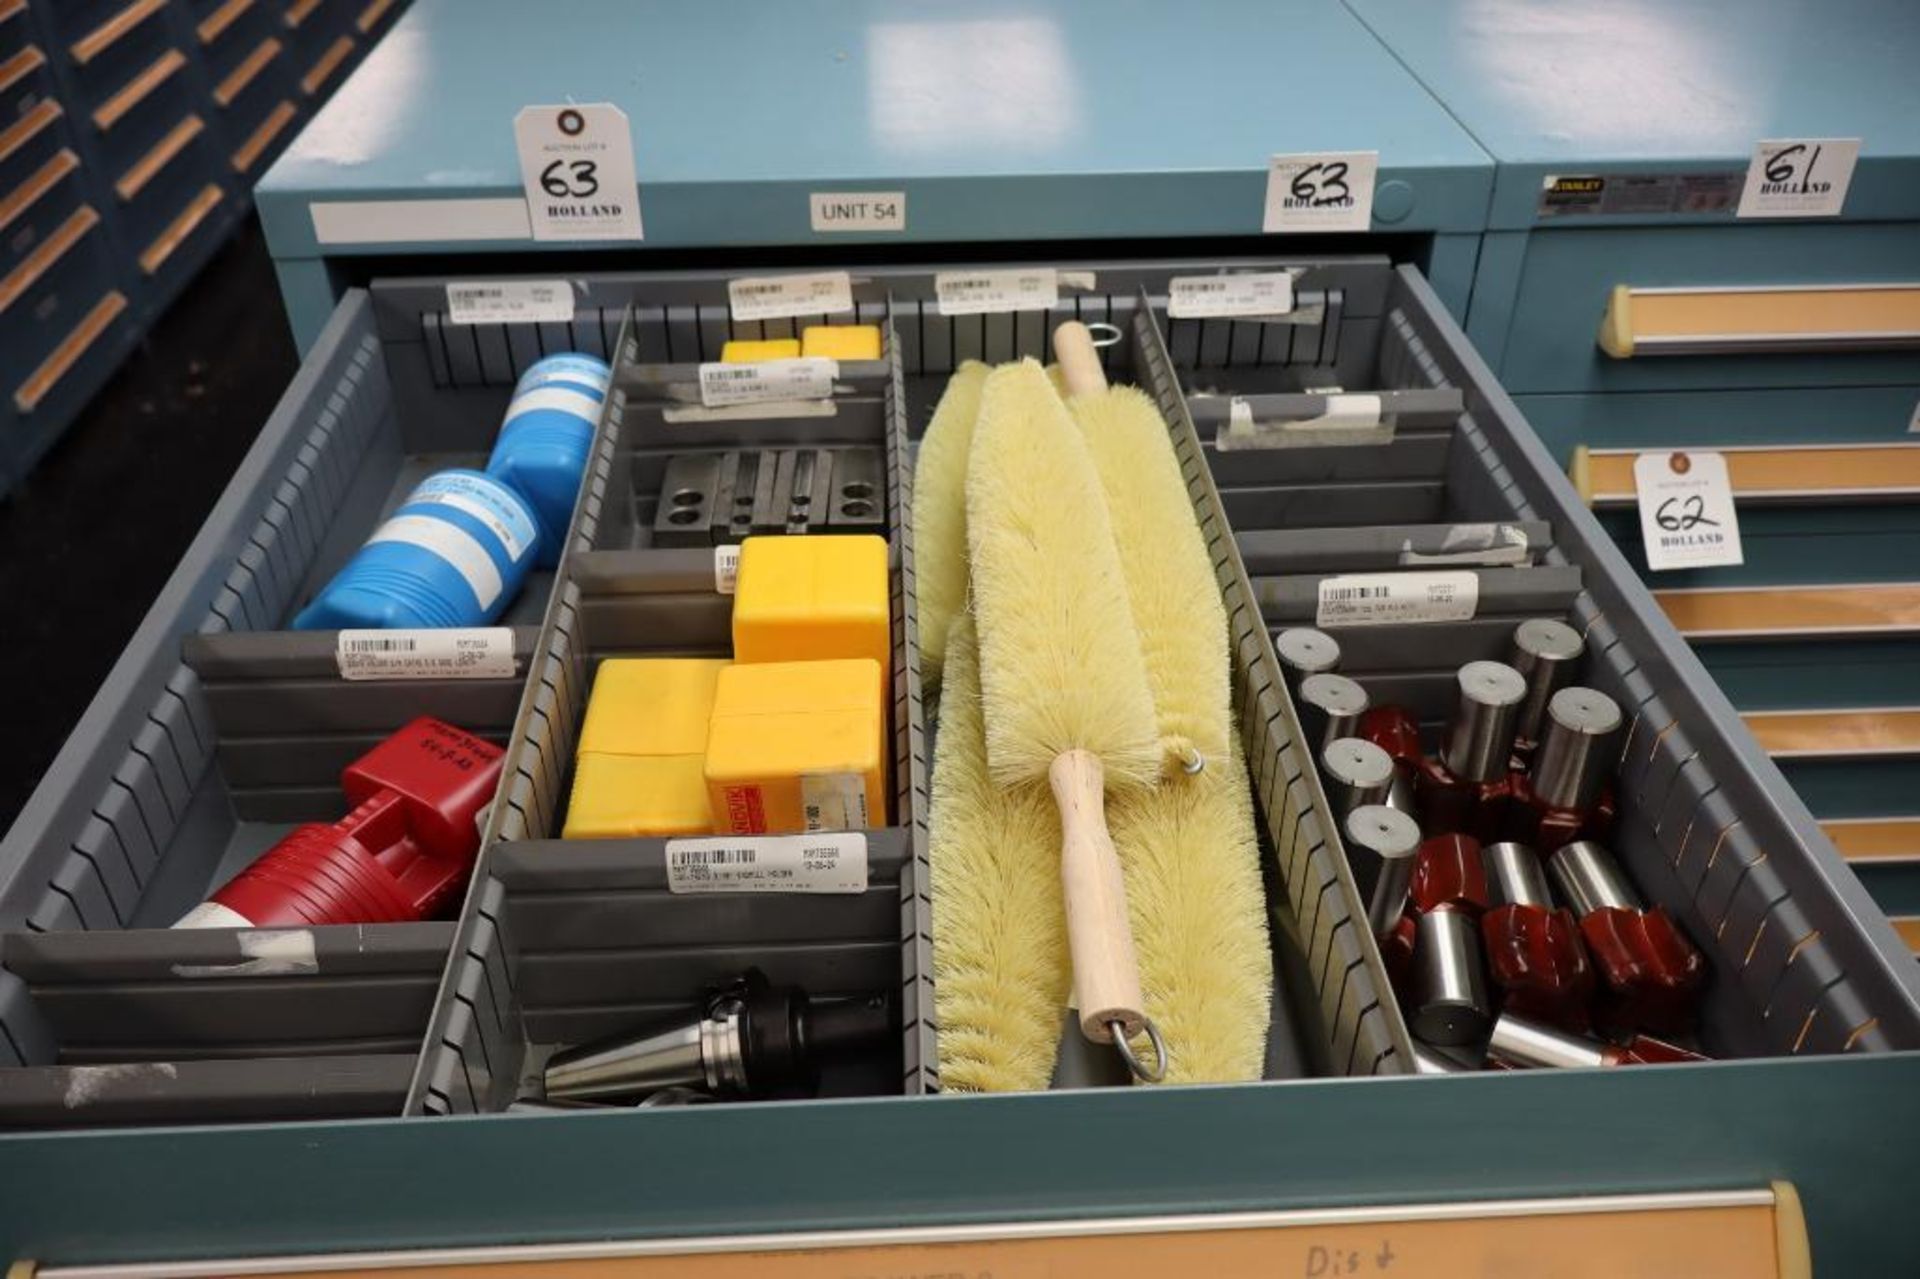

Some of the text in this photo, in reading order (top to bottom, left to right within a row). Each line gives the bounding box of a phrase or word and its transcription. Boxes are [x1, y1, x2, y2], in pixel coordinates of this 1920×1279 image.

[540, 159, 599, 198] 63
[1766, 144, 1821, 194] 61
[1291, 162, 1350, 206] 63
[1555, 179, 1600, 191] STANLEY
[547, 204, 622, 218] HOLLAND
[821, 202, 897, 221] UNIT 54
[1283, 196, 1355, 209] HOLND
[1655, 495, 1720, 531] 62
[1660, 533, 1724, 547] HOLLAND
